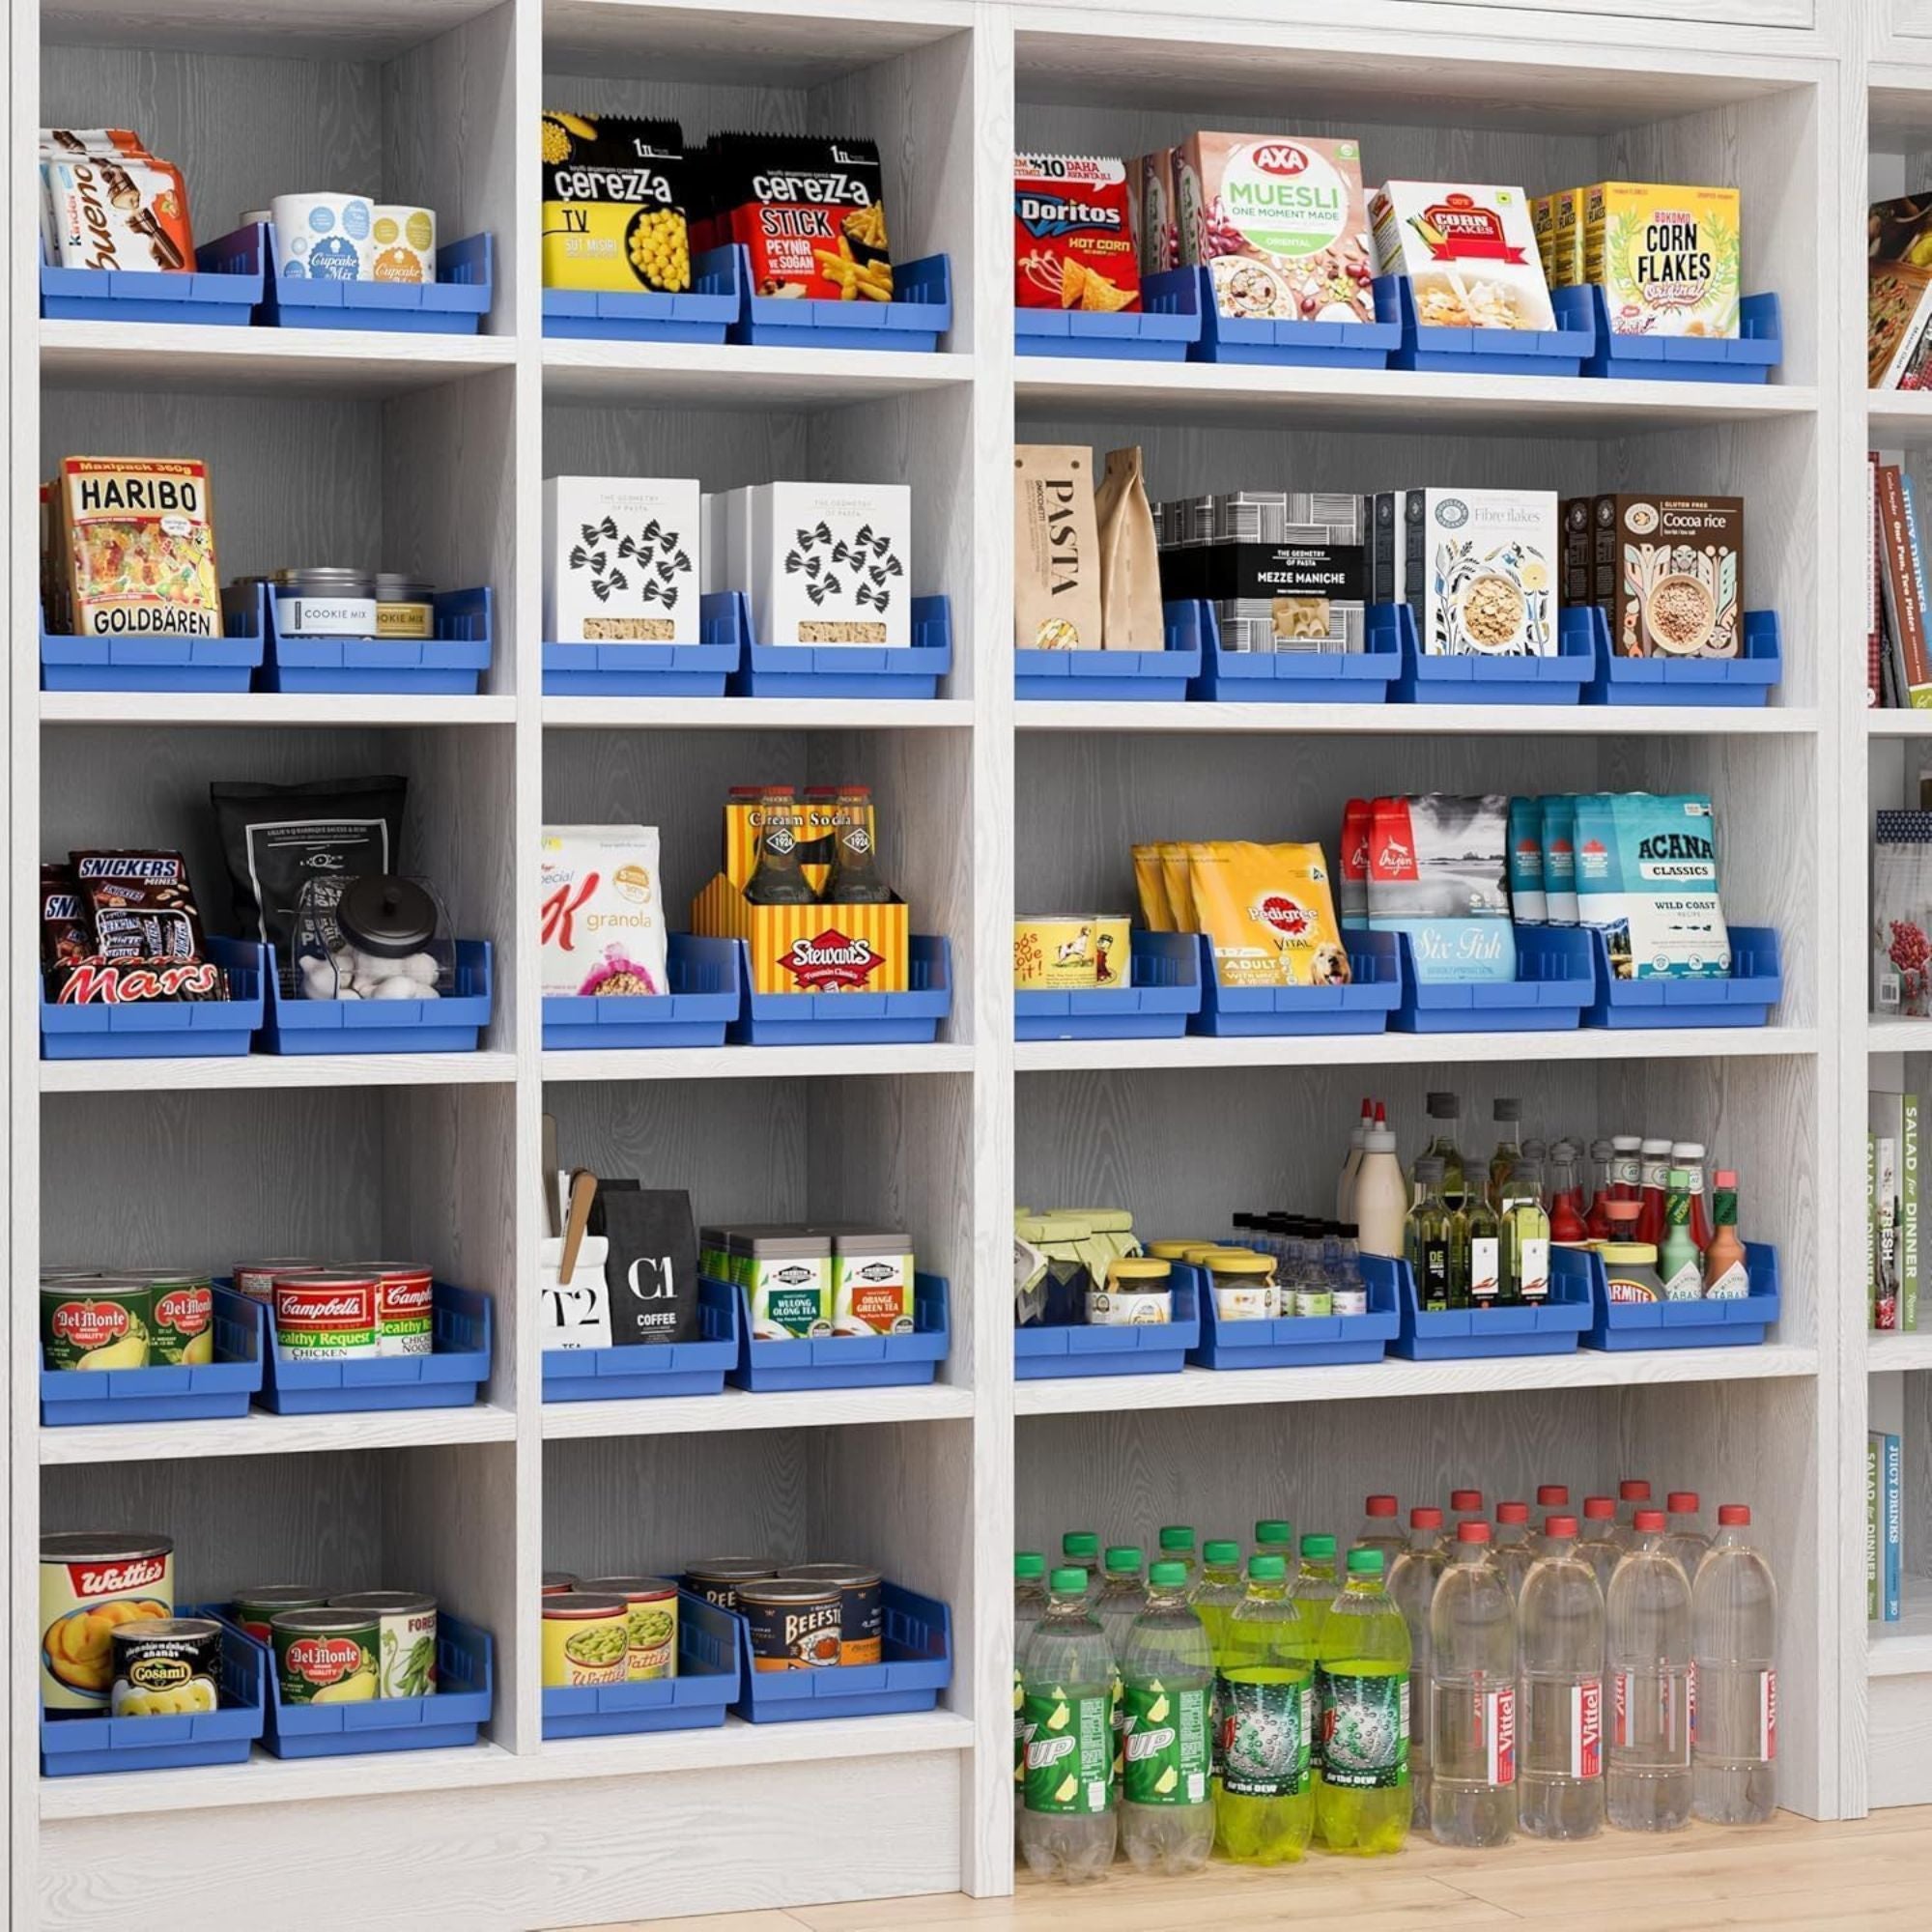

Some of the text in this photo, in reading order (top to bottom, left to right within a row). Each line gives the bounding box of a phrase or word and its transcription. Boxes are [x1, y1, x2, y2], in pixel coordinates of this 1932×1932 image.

[1066, 161, 1099, 172] DAHA
[1258, 147, 1304, 170] AXA
[1230, 182, 1339, 209] MUESLI
[561, 210, 587, 231] TV
[1022, 199, 1121, 223] Doritos
[1232, 207, 1340, 220] ONE MOMENT MADE
[1435, 213, 1489, 226] CORN
[1655, 212, 1691, 223] BOKOMO
[760, 208, 835, 238] STICK
[1437, 224, 1493, 235] FLAKES
[1068, 239, 1130, 251] HOT CORN
[1266, 237, 1310, 247] ORIENTAL
[1647, 224, 1697, 251] CORN
[311, 253, 357, 268] Cupcake
[375, 263, 420, 277] Cupcake
[1638, 253, 1711, 282] FLAKES
[81, 479, 197, 511] HARIBO
[1663, 513, 1701, 527] Cocoa
[1704, 513, 1726, 527] rice
[1045, 480, 1079, 596] PASTA
[1893, 521, 1902, 543] One
[1258, 572, 1345, 584] MEZZE MANICHE
[1901, 573, 1910, 595] Two
[95, 606, 211, 636] GOLDBÄREN
[305, 610, 347, 618] COOKIE
[377, 613, 424, 623] OKIE MIX
[1905, 597, 1915, 632] Plates
[749, 810, 851, 826] Cream Soda
[776, 837, 793, 847] 1924
[851, 837, 868, 847] 1924
[1638, 834, 1714, 859] ACANA
[80, 858, 178, 877] SNICKERS
[1653, 867, 1709, 875] CLASSICS
[542, 871, 600, 952] K
[1248, 907, 1318, 923] Pedigree
[586, 912, 651, 932] granola
[1014, 933, 1038, 955] ogs
[1418, 927, 1501, 959] Six Fish
[1225, 959, 1276, 970] ADULT
[57, 964, 217, 1004] Mars
[1906, 1105, 1918, 1171] SALAD
[1906, 1177, 1916, 1196] for
[1882, 1209, 1895, 1261] FRESH
[1906, 1202, 1918, 1279] DINNER
[163, 1301, 185, 1316] Del
[281, 1295, 361, 1320] Campbell's
[542, 1288, 600, 1327] T2
[857, 1303, 898, 1313] GREEN TEA
[862, 1295, 893, 1304] ORANGE
[58, 1310, 125, 1327] Del Monte
[638, 1313, 676, 1326] COFFEE
[803, 1307, 817, 1316] TEA
[280, 1330, 370, 1348] ealthy Request
[292, 1348, 348, 1357] CHICKEN
[1889, 1445, 1899, 1545] JUICY DRINKS
[292, 1646, 357, 1662] Del Monte
[1498, 1695, 1514, 1754] Vittel
[1583, 1689, 1599, 1747] Vittel
